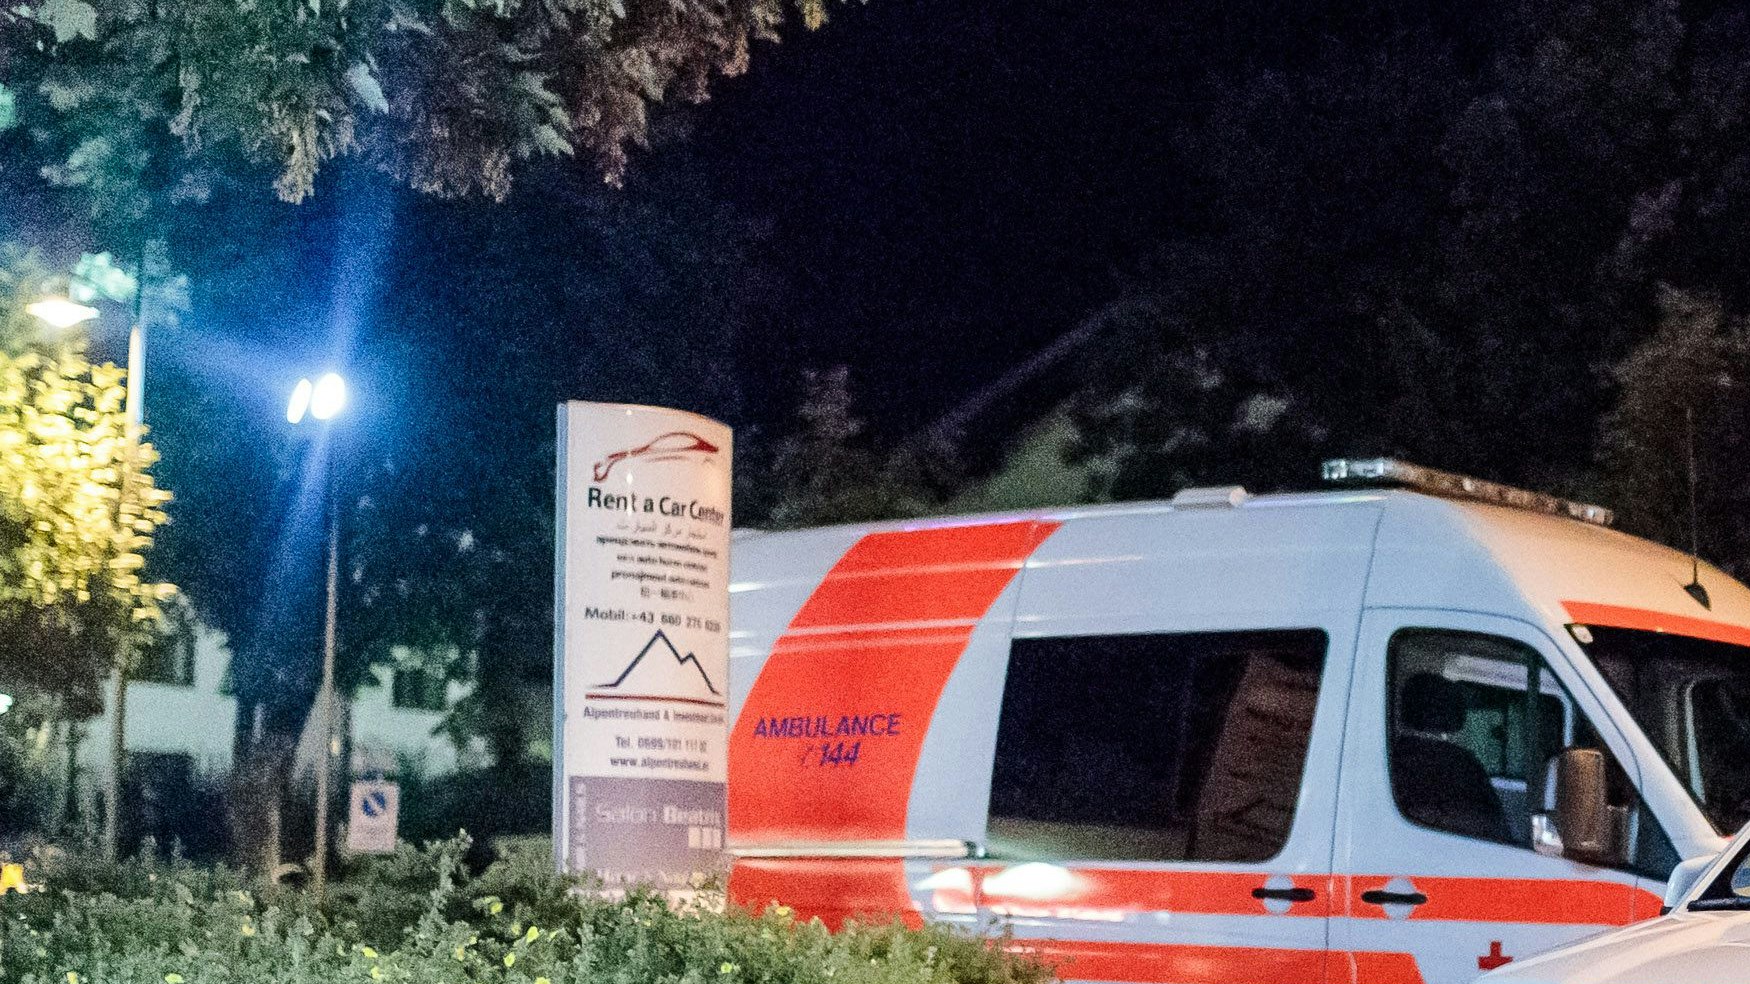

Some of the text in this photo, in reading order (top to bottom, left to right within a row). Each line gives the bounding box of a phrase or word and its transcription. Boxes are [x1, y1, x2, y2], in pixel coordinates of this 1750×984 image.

[587, 487, 636, 513] Rent
[643, 497, 655, 513] a
[659, 496, 687, 517] Car
[754, 711, 903, 739] AMBULANCE
[819, 741, 862, 767] 144
